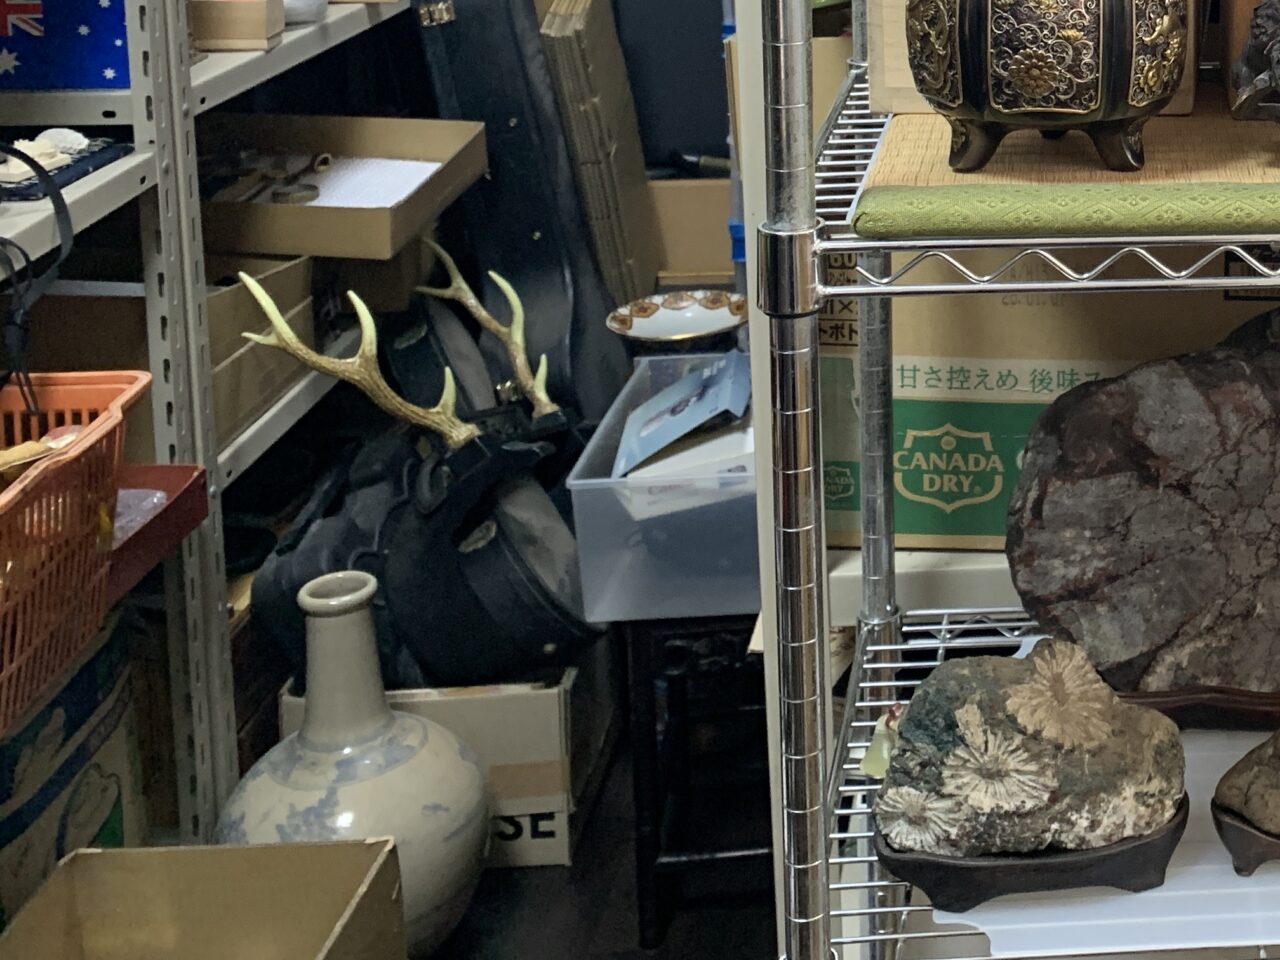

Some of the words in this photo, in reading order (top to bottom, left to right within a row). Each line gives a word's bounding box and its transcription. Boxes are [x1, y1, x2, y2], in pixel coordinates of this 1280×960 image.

[895, 364, 1019, 390] 甘さ控えめ
[893, 451, 1004, 472] CANADA
[923, 473, 974, 493] DRY
